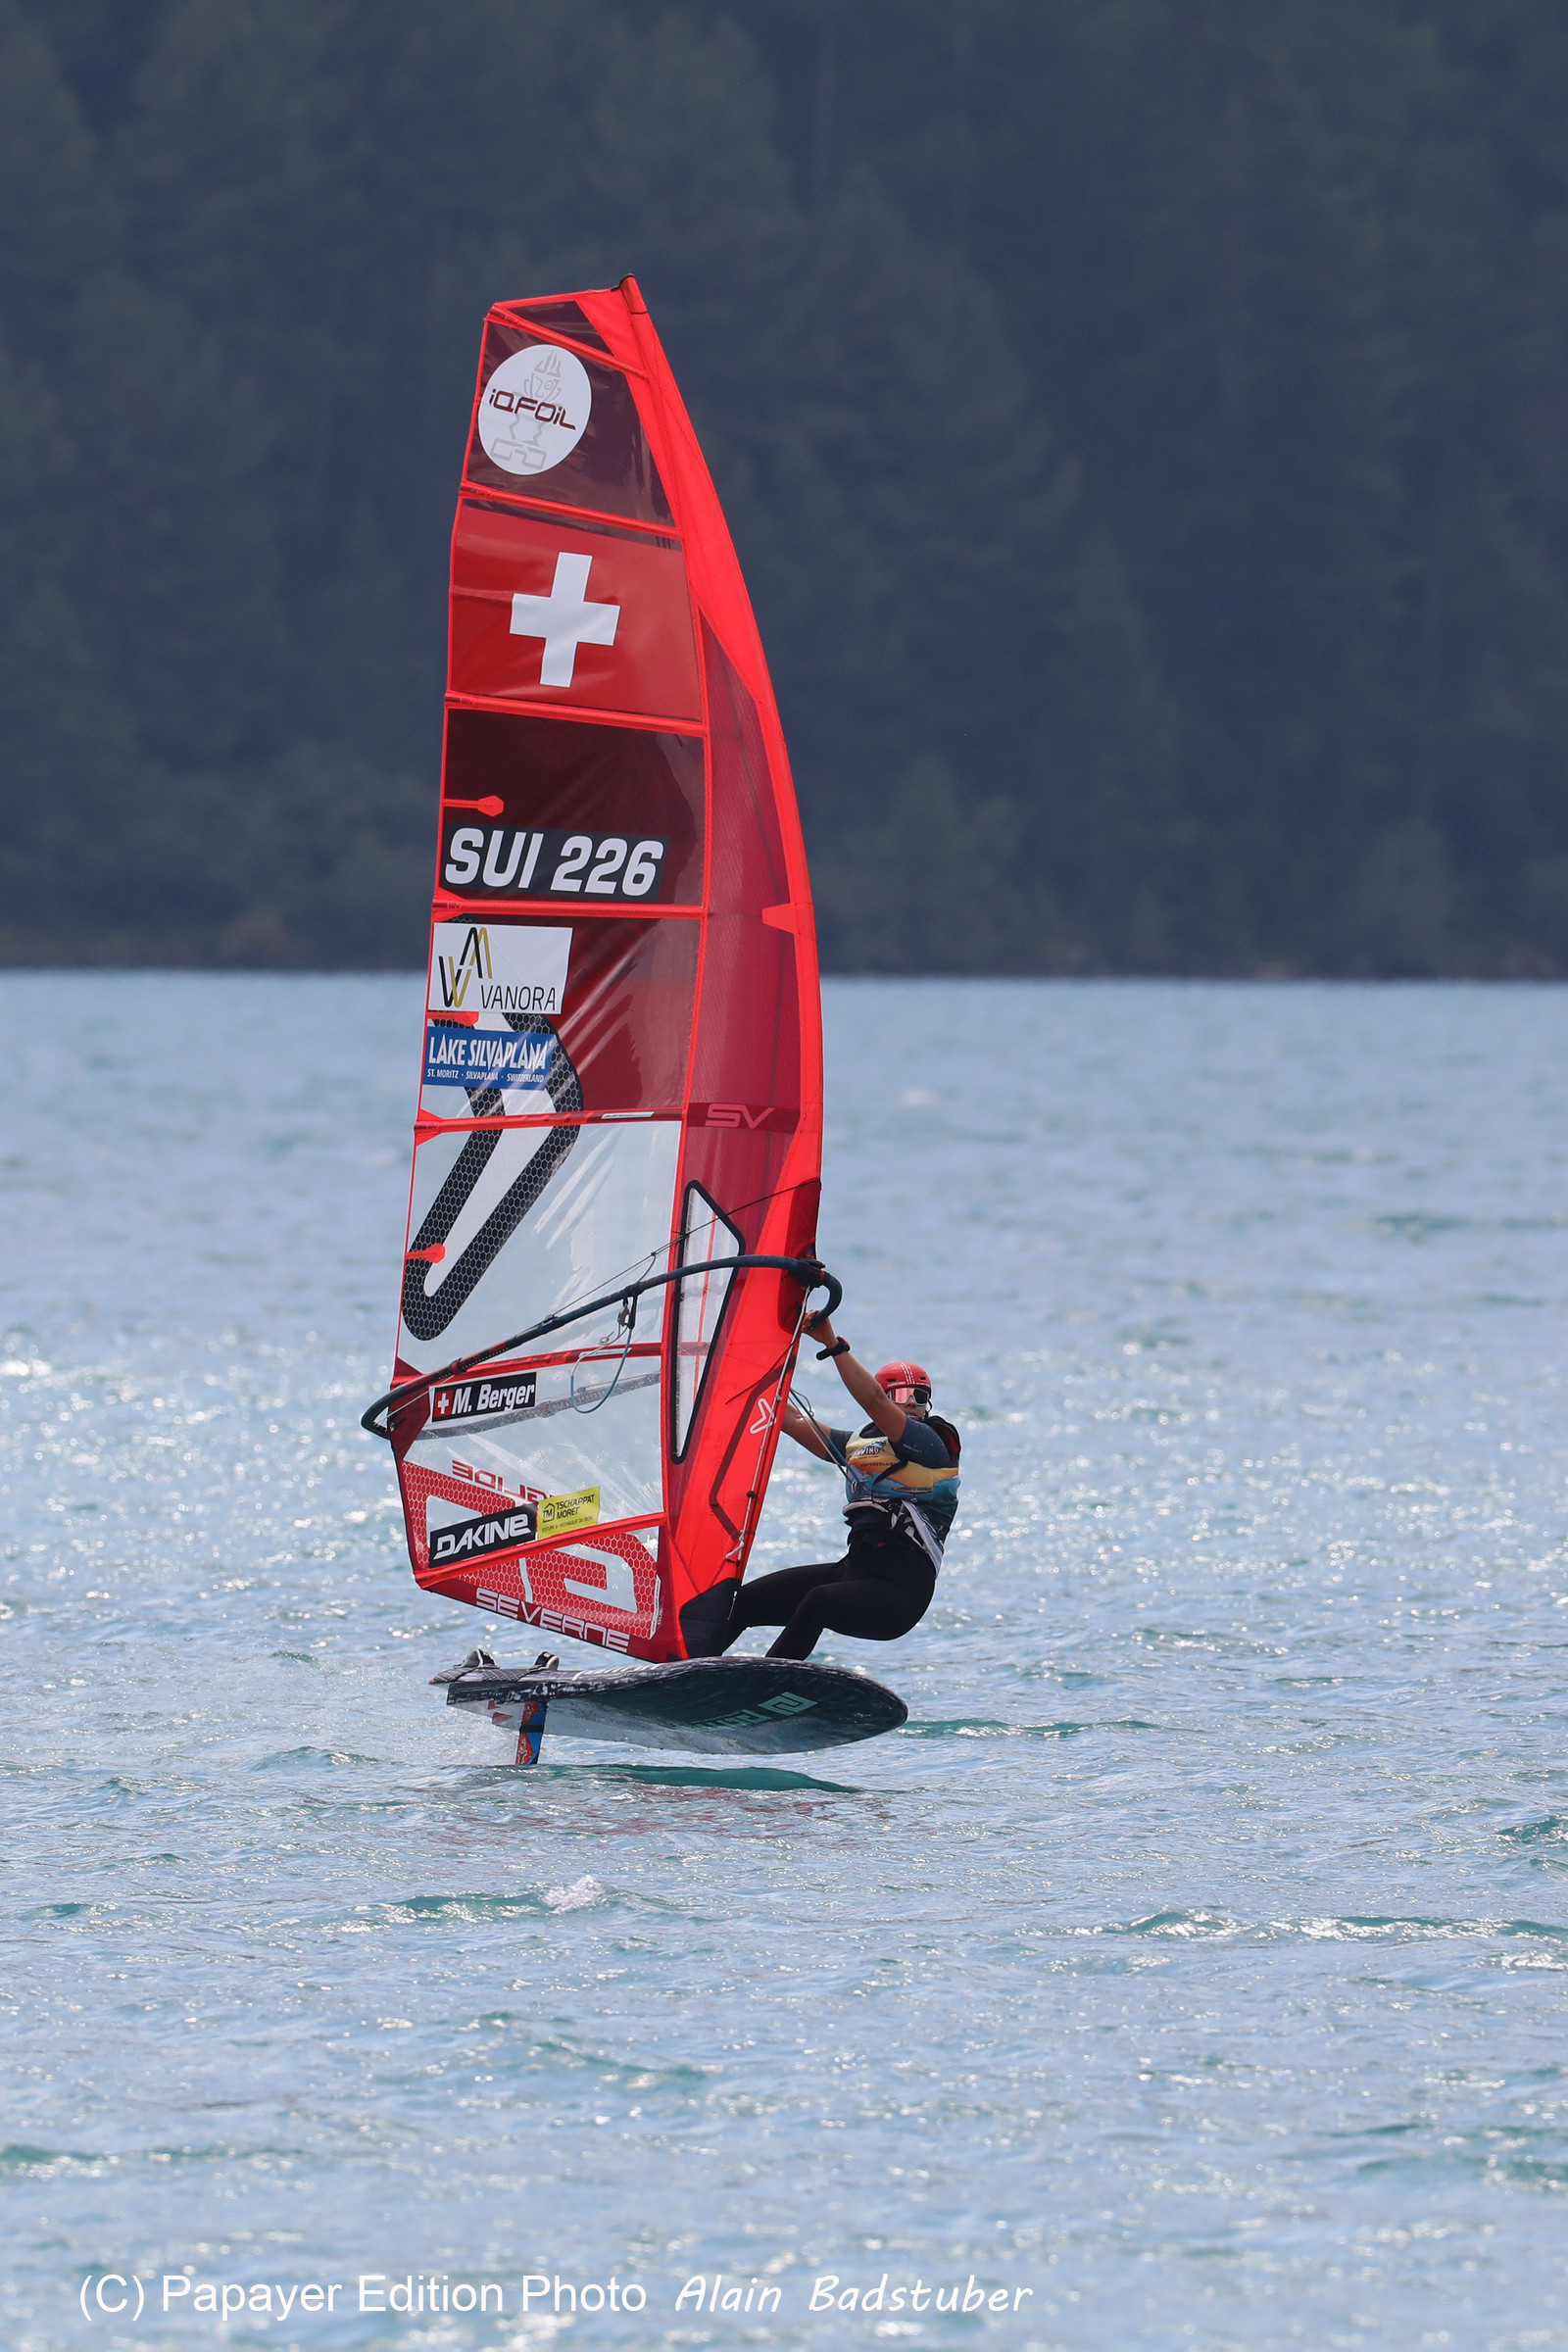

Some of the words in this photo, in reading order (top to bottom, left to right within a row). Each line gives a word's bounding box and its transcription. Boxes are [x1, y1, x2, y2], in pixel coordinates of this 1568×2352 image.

[445, 827, 544, 889] SUI
[550, 835, 664, 897] 226
[480, 985, 557, 1011] VANORA
[428, 1034, 467, 1066] LAKE
[467, 1037, 548, 1073] SILVAPLANA
[436, 1069, 459, 1079] MORITZ
[466, 1070, 499, 1081] SILVAPLANA
[507, 1073, 545, 1083] SWITZERLAND
[451, 1386, 472, 1415] M.
[476, 1384, 535, 1412] Berger
[557, 1506, 580, 1519] MORET
[475, 1587, 631, 1653] SEVERNE
